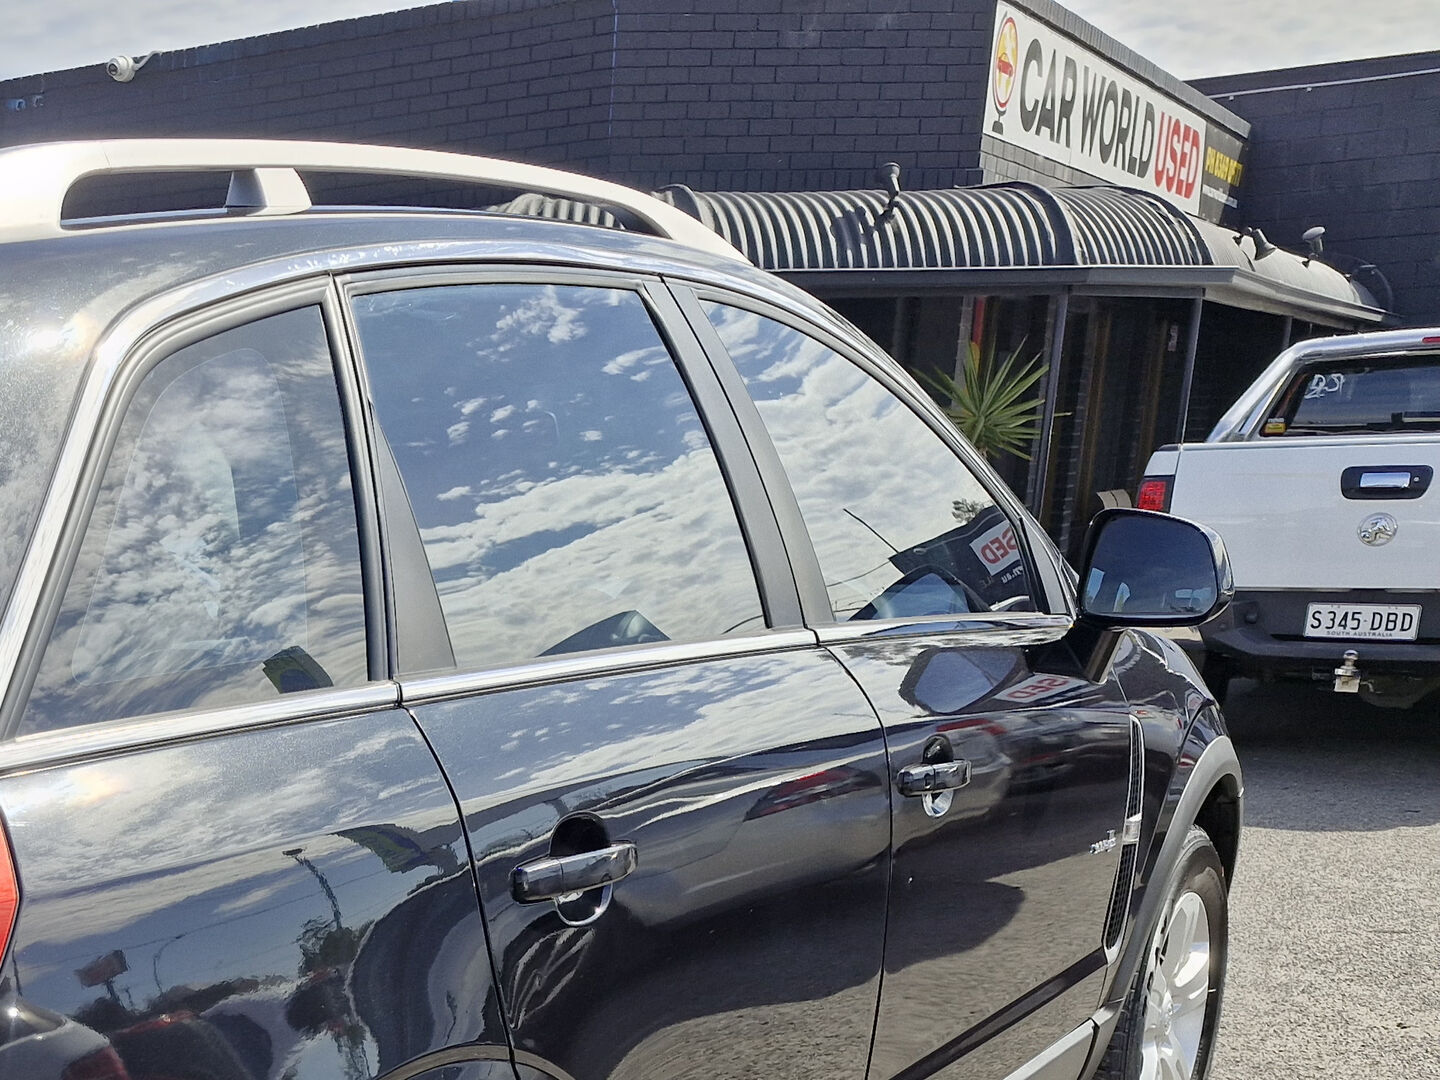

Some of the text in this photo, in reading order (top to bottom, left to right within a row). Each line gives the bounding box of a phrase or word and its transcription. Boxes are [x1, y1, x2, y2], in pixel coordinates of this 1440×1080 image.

[1020, 37, 1200, 200] CAR WORLD USED
